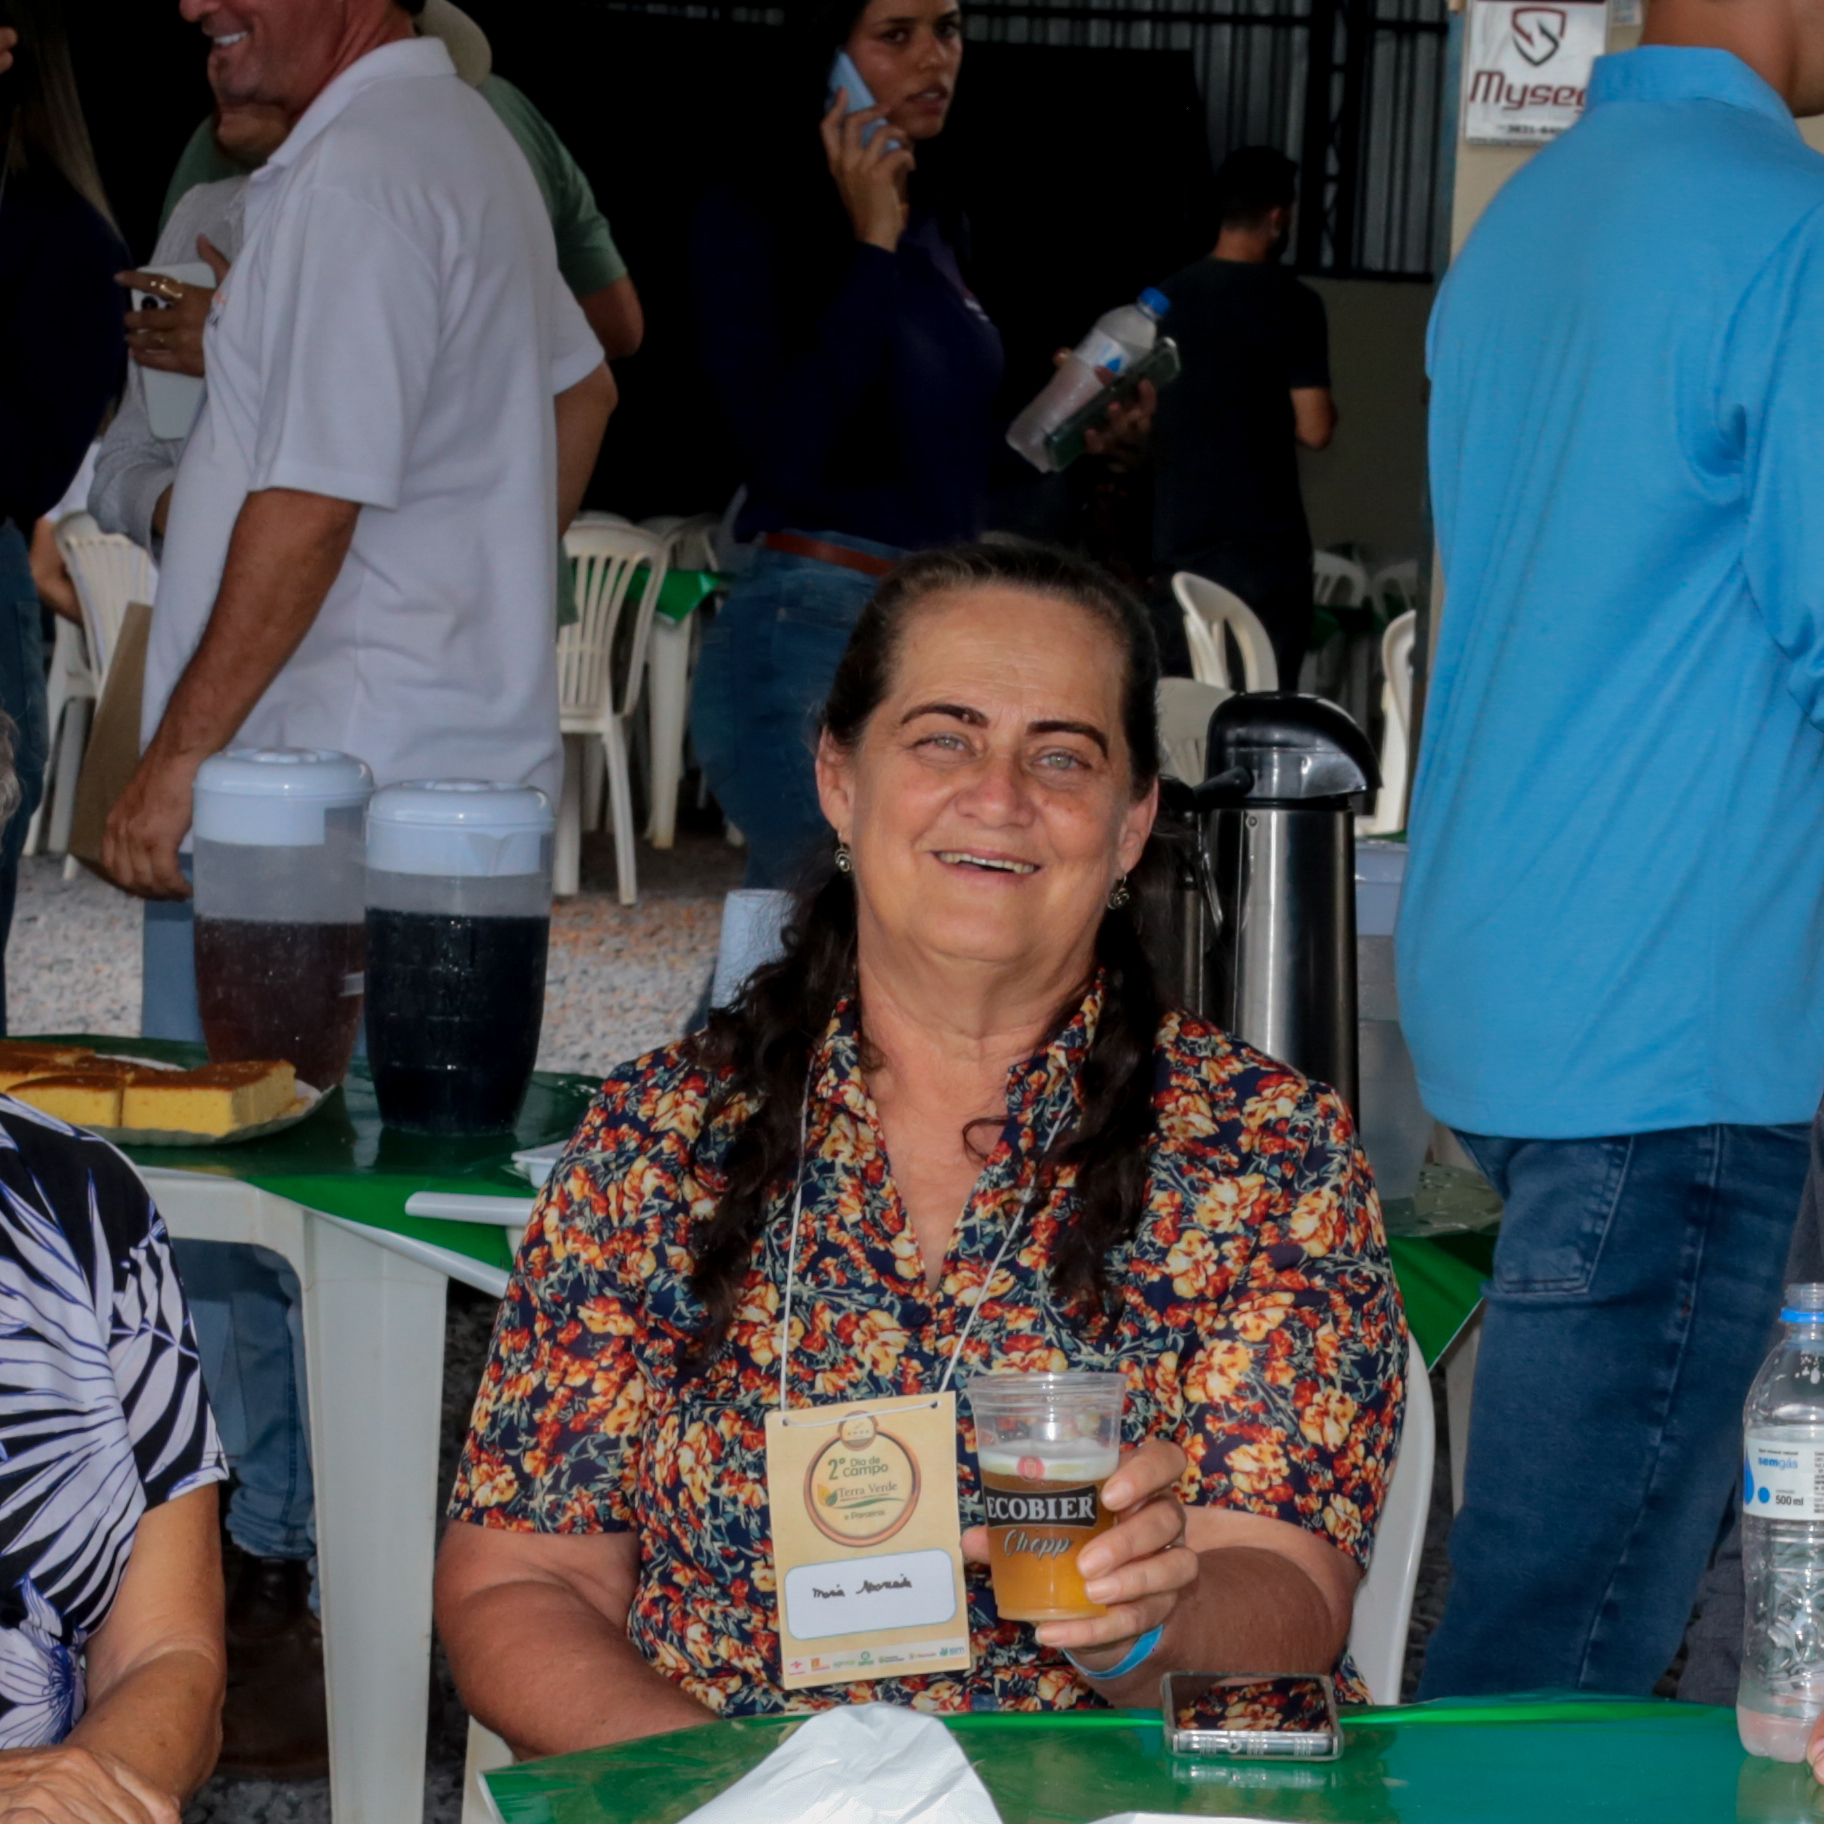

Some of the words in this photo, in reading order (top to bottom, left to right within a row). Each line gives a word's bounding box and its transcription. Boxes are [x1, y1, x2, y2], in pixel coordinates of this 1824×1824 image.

[842, 1463, 889, 1478] Campo
[838, 1487, 866, 1498] Terra
[868, 1481, 898, 1493] Verde
[986, 1495, 1096, 1520] ECOBIER
[1775, 1494, 1792, 1506] 500
